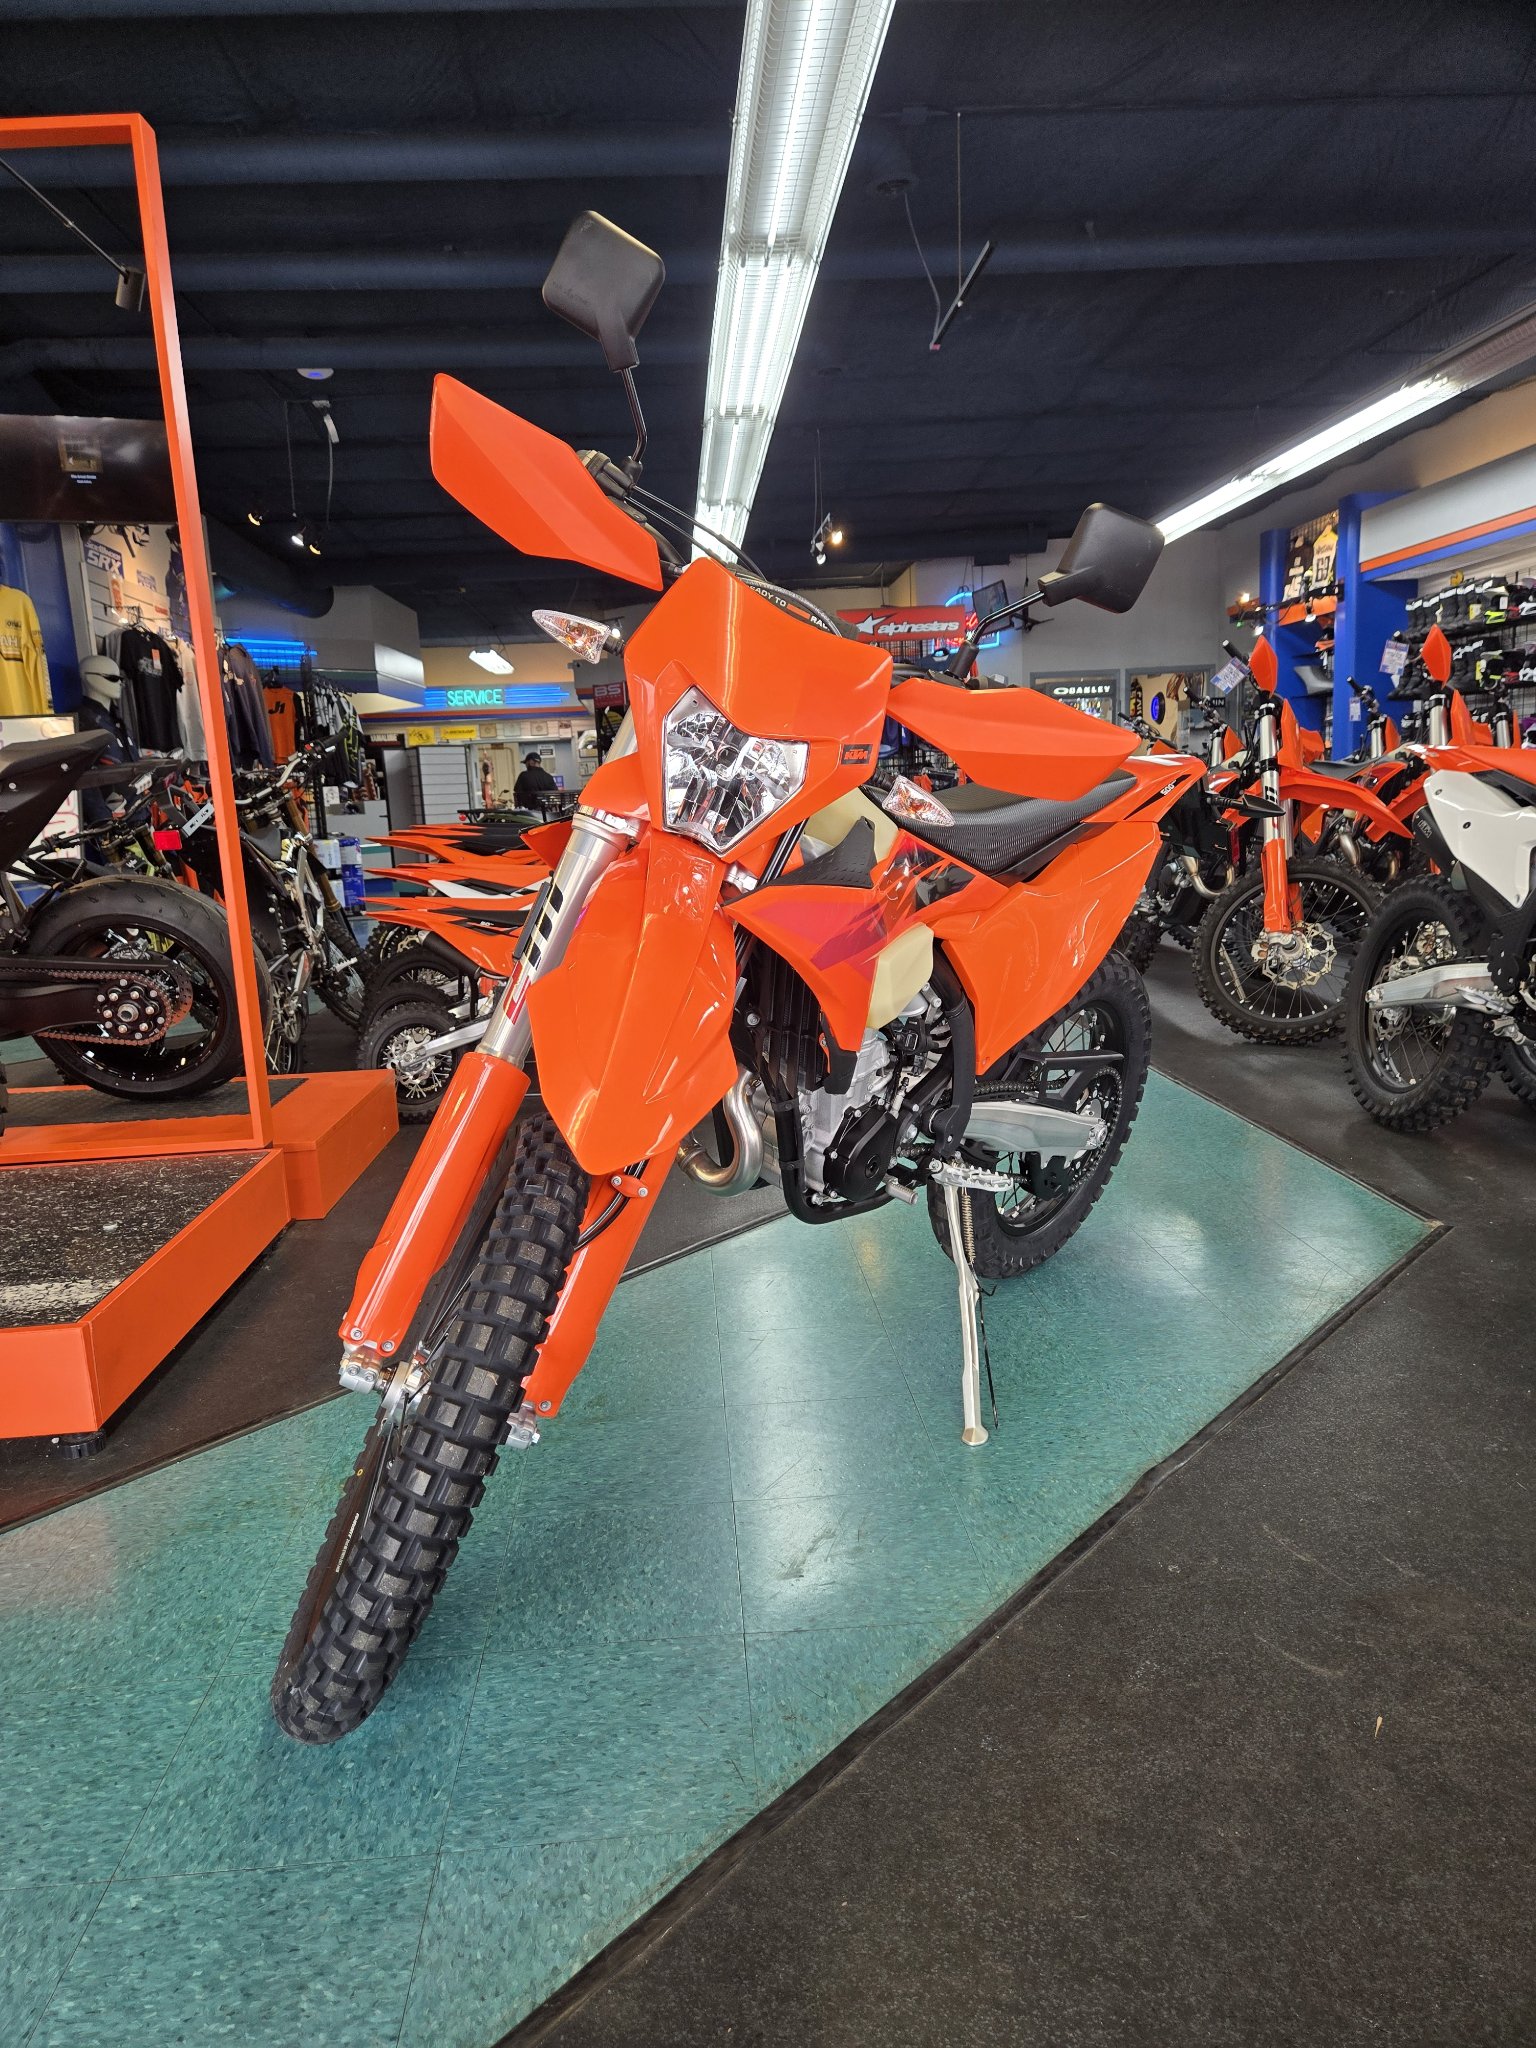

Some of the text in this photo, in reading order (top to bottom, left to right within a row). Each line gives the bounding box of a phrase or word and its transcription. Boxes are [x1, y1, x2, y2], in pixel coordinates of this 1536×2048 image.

[775, 596, 787, 607] TO
[877, 620, 959, 636] alpinestars
[594, 684, 621, 696] BS
[1068, 685, 1110, 695] OAKLEY
[447, 688, 504, 706] SERVICE
[844, 751, 868, 760] KTM
[1160, 783, 1176, 796] 500
